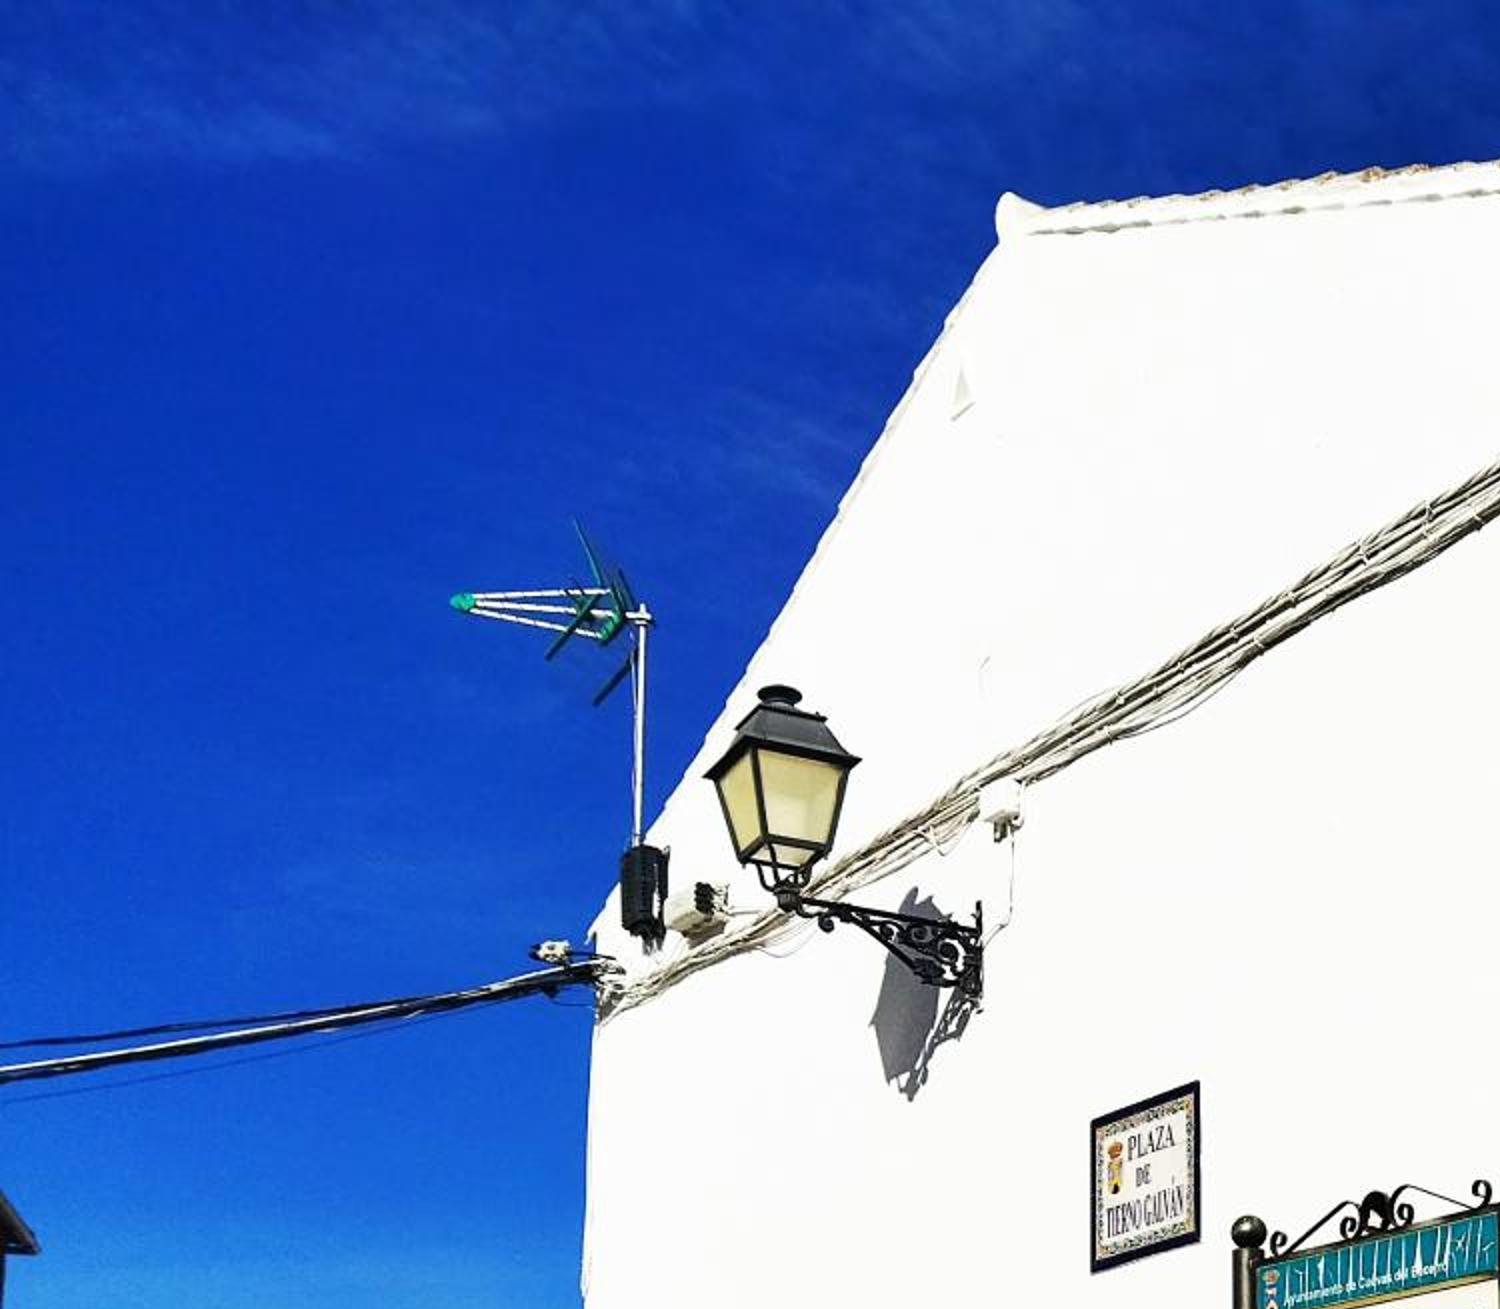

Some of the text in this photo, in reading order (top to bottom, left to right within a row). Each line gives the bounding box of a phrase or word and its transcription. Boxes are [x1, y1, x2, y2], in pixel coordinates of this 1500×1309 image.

[1127, 1123, 1176, 1161] PLAZA
[1135, 1163, 1152, 1187] DE
[1107, 1199, 1142, 1239] TIERNO
